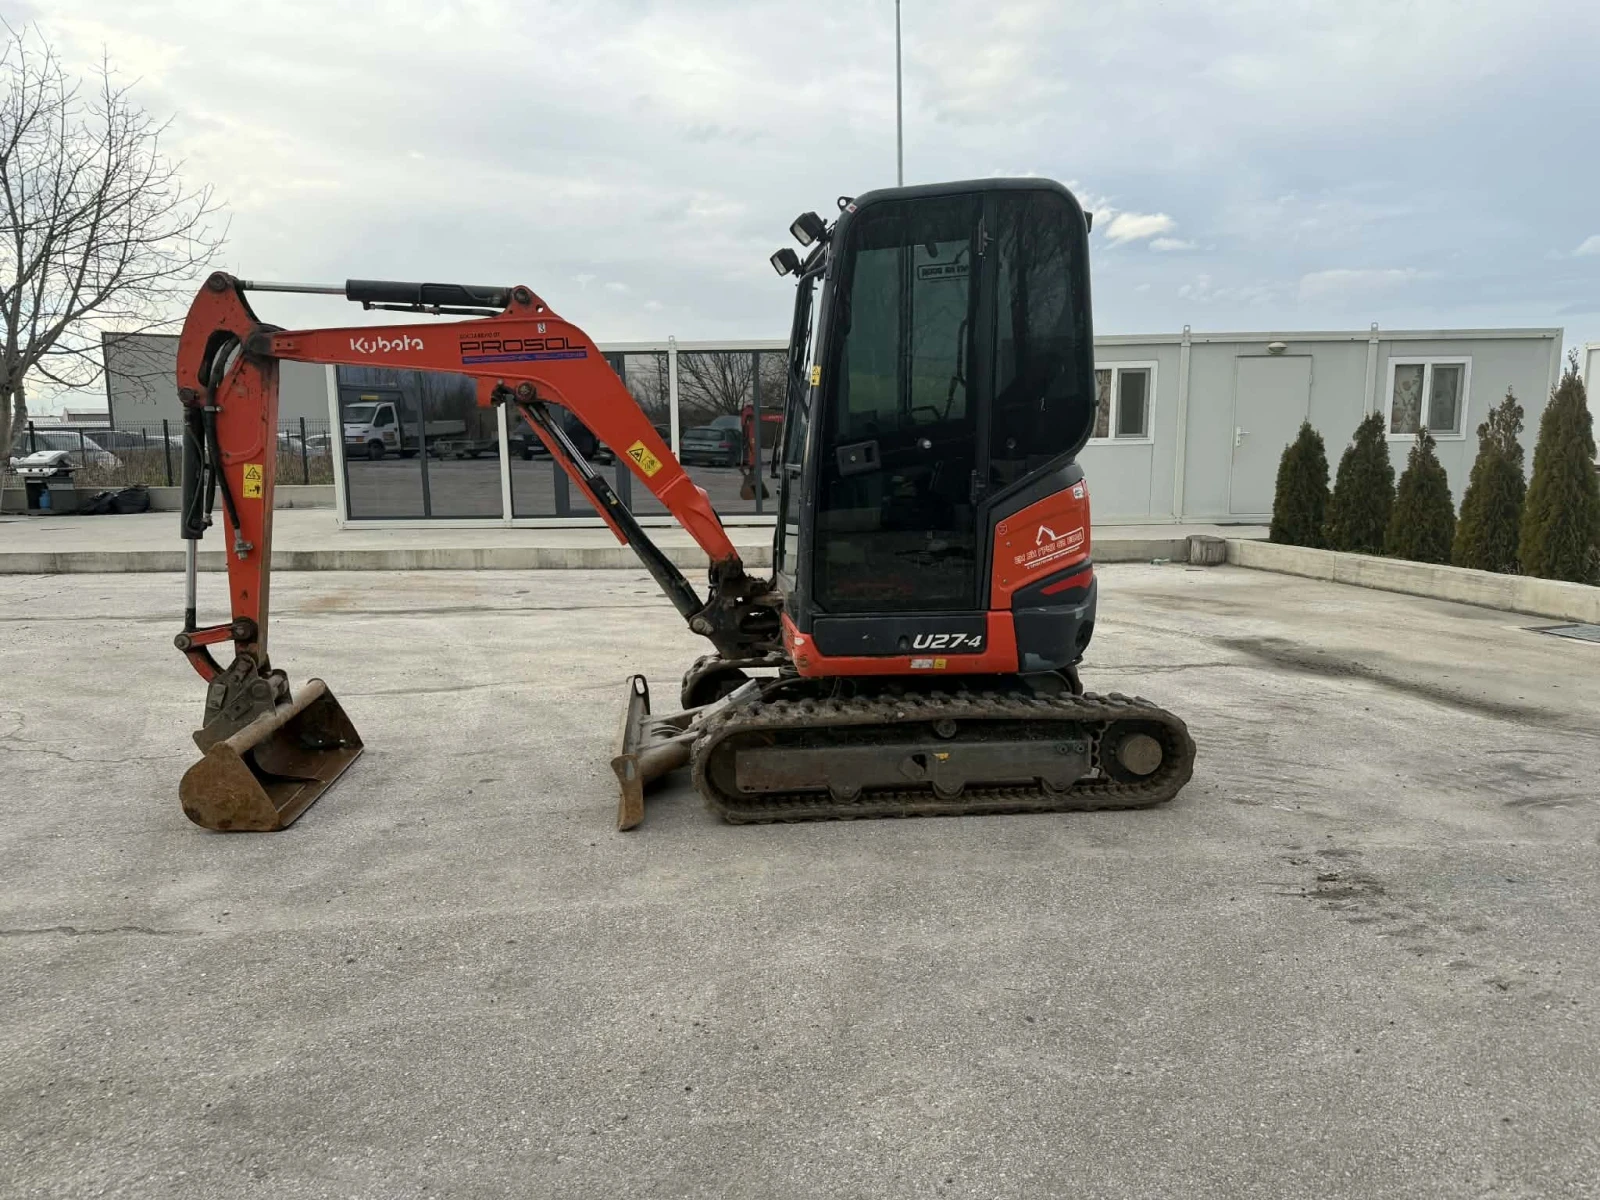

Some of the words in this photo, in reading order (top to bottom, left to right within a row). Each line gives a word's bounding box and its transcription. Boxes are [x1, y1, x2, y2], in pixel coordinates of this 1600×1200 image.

[350, 335, 424, 353] Kubota
[460, 337, 586, 354] PROSOL
[912, 633, 982, 649] U27-4
